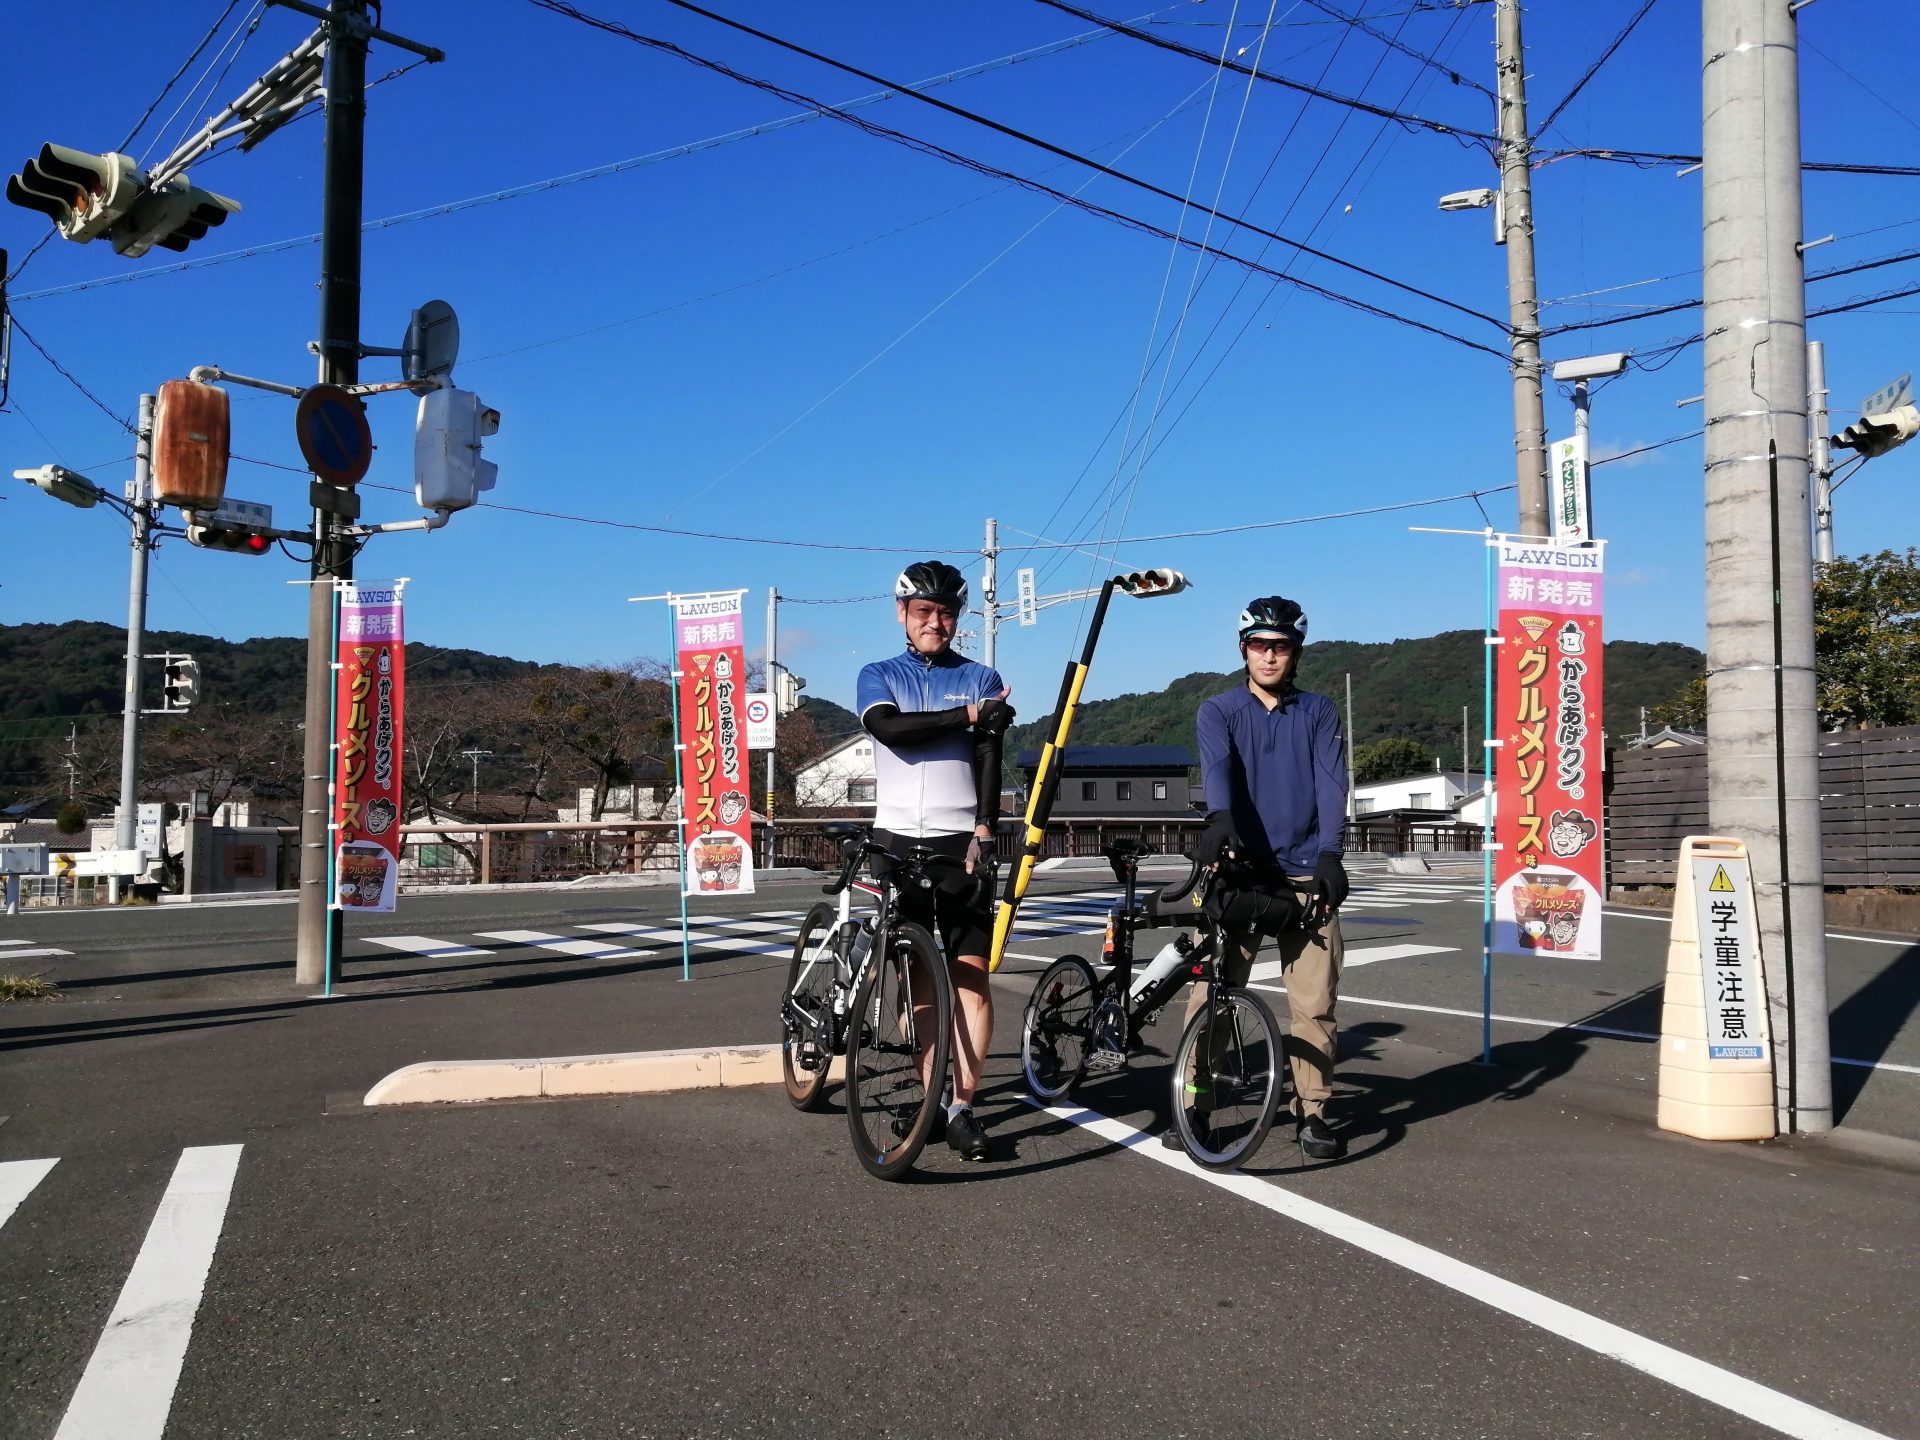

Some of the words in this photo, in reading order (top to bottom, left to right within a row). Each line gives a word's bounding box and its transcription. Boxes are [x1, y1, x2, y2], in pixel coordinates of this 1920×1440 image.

[1504, 548, 1598, 568] LAWSON
[345, 590, 403, 604] LAWSON
[1507, 575, 1593, 607] 新発売
[680, 599, 738, 616] LAWSON
[346, 614, 397, 636] 新発売
[683, 621, 736, 645] 新発売
[1711, 900, 1748, 1039] 学童注意
[1714, 1047, 1758, 1057] LAWSON
